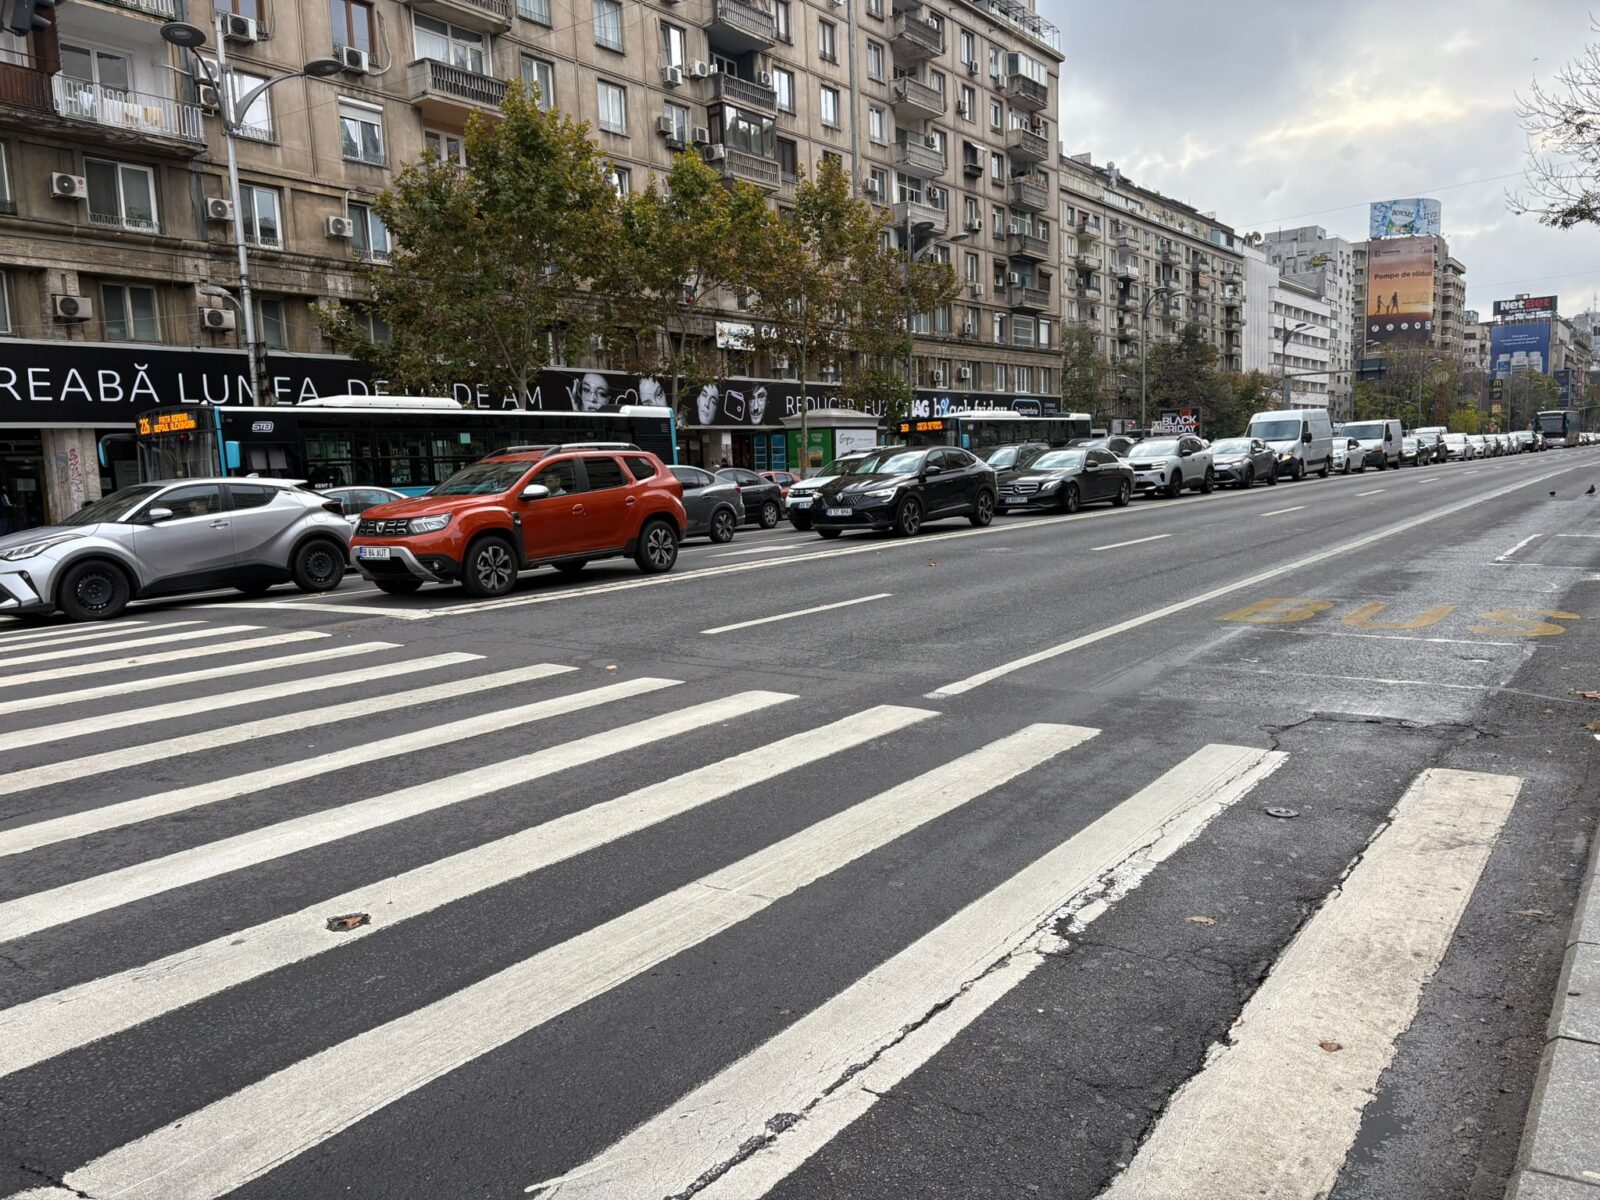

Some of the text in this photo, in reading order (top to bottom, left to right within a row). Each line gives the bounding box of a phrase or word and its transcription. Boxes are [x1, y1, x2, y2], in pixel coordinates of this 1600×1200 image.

[1374, 272, 1400, 281] Pompe
[1162, 415, 1197, 426] BLACK
[251, 421, 274, 432] STB
[1162, 424, 1196, 433] FRIDAY
[1220, 597, 1581, 637] BUS
